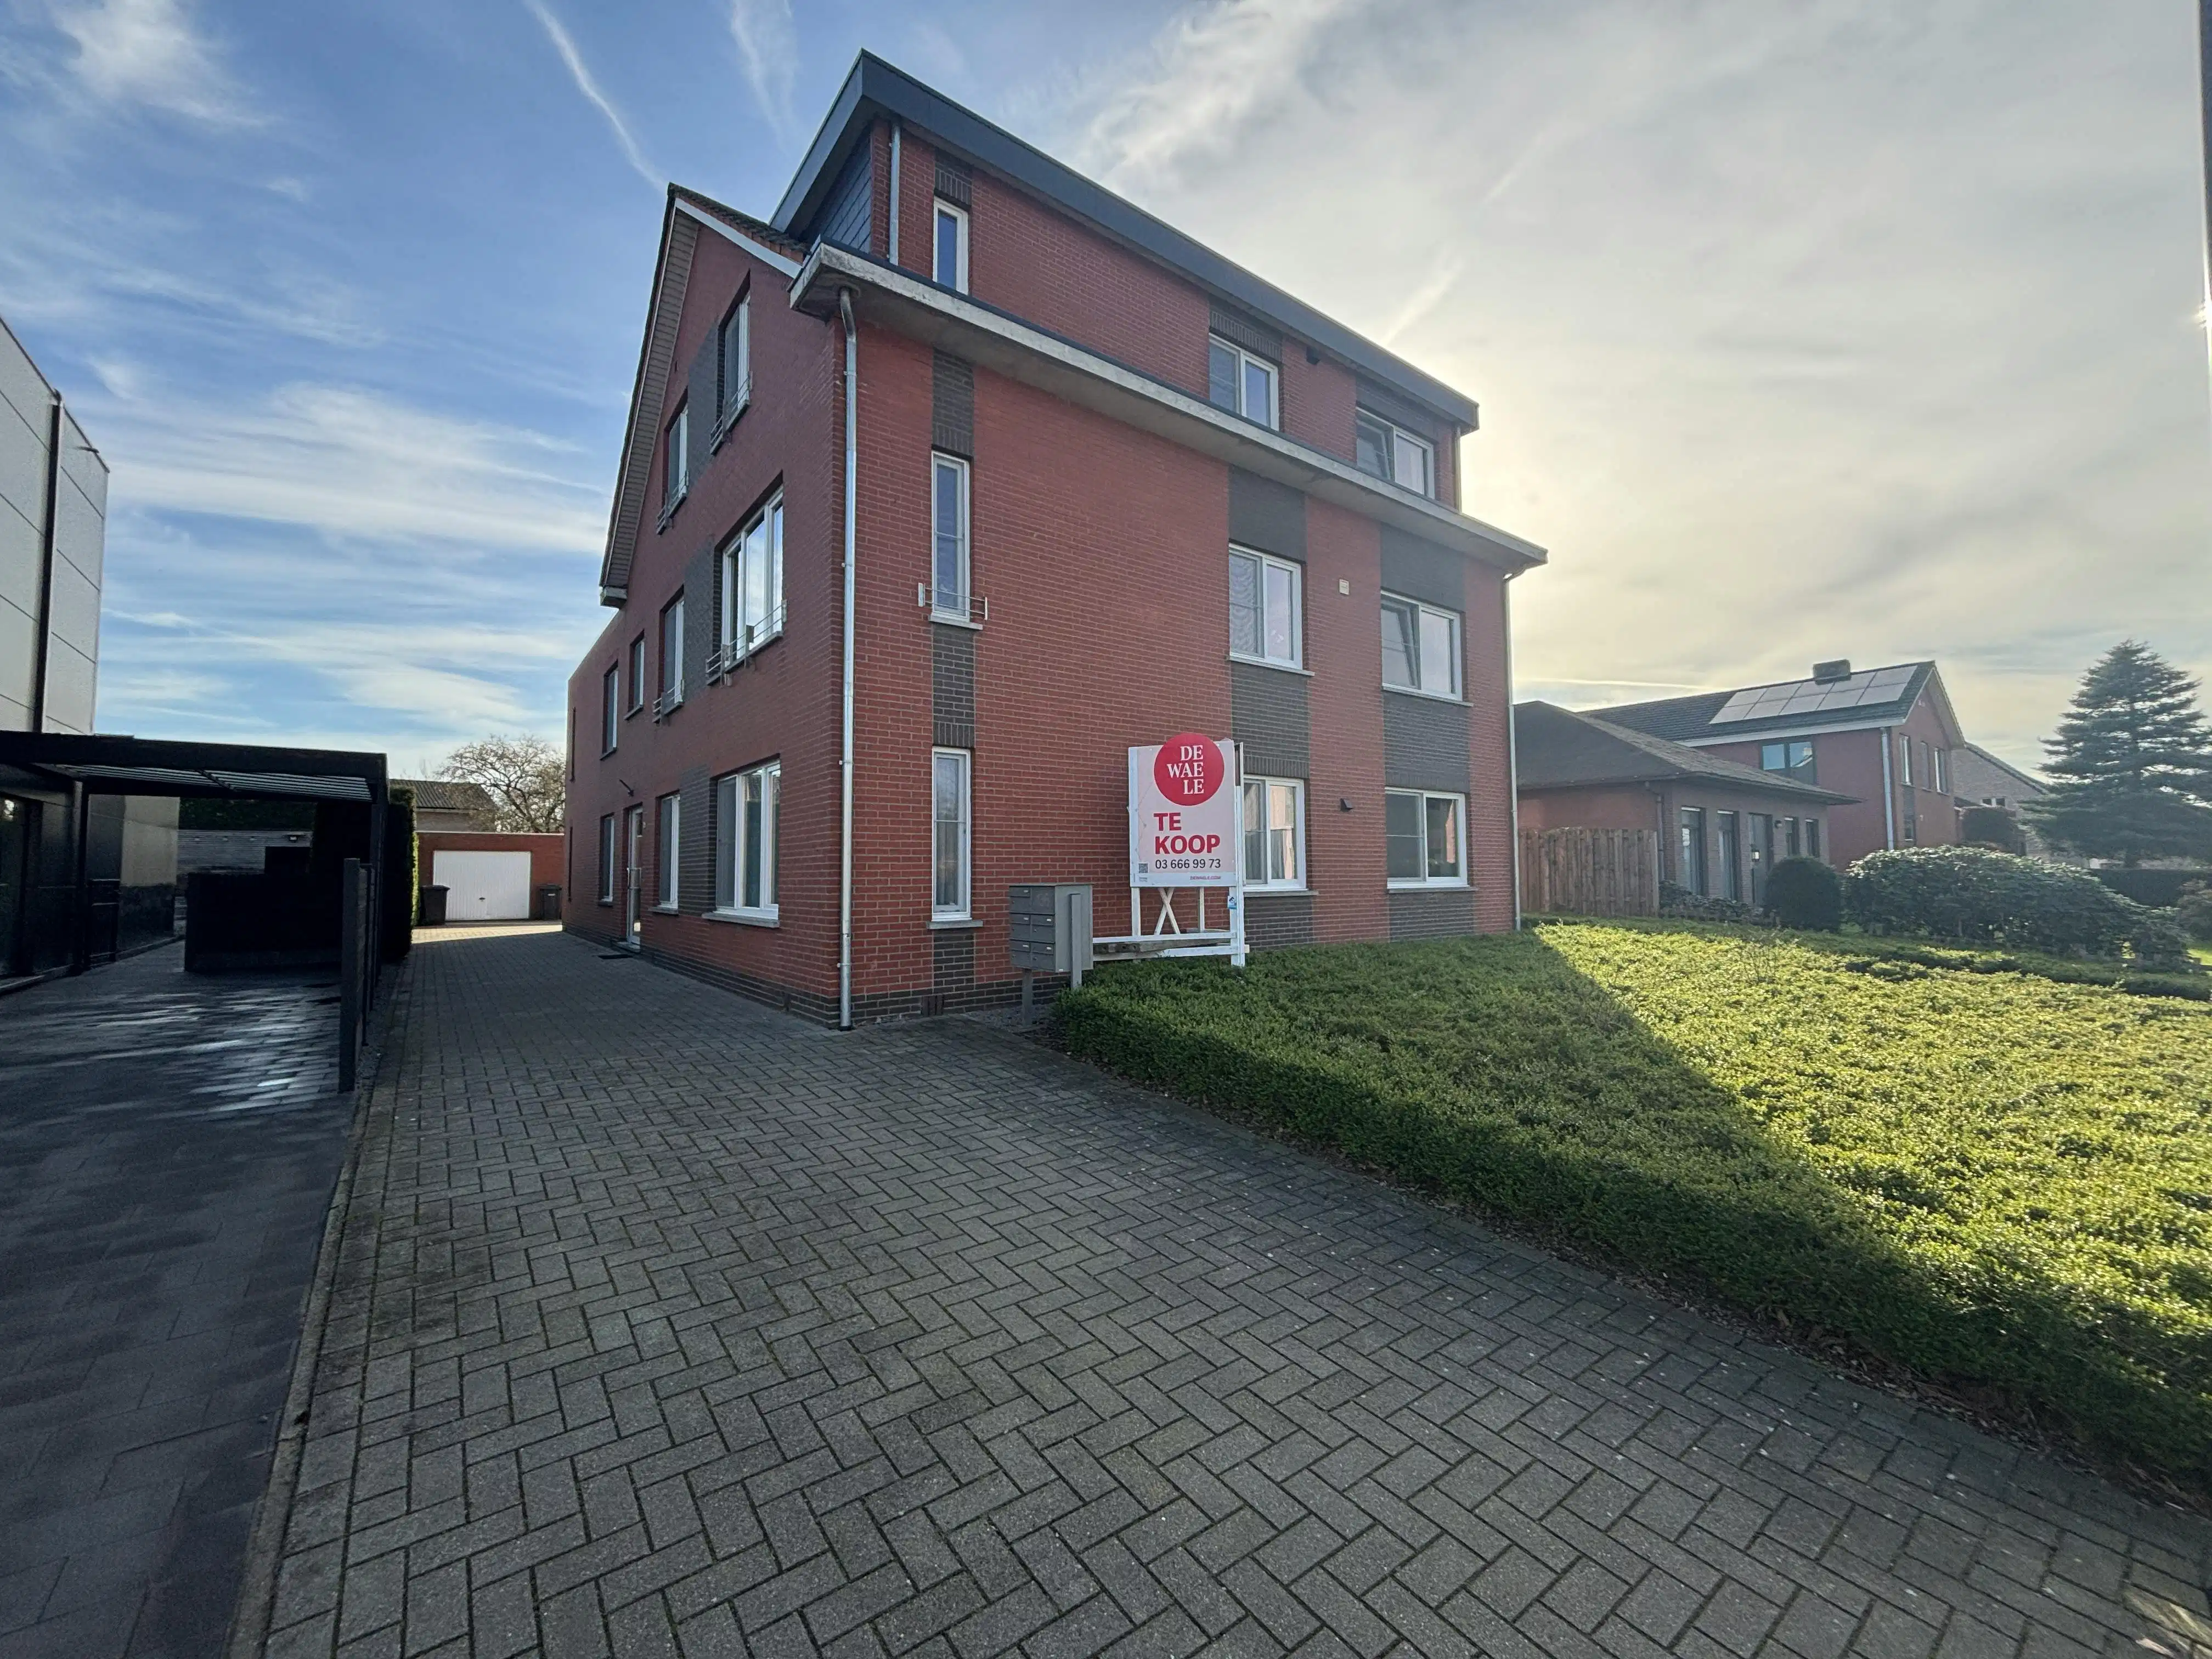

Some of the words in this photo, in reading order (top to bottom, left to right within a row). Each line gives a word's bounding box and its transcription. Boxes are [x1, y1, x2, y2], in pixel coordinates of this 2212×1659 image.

[1181, 745, 1203, 761] DE
[1167, 762, 1204, 778] WAE
[1183, 780, 1204, 794] LE
[1154, 812, 1182, 831] TE
[1155, 835, 1220, 855] KOOP
[1155, 860, 1167, 869] 03
[1170, 859, 1190, 868] 666
[1193, 859, 1206, 868] 99
[1209, 859, 1221, 868] 73
